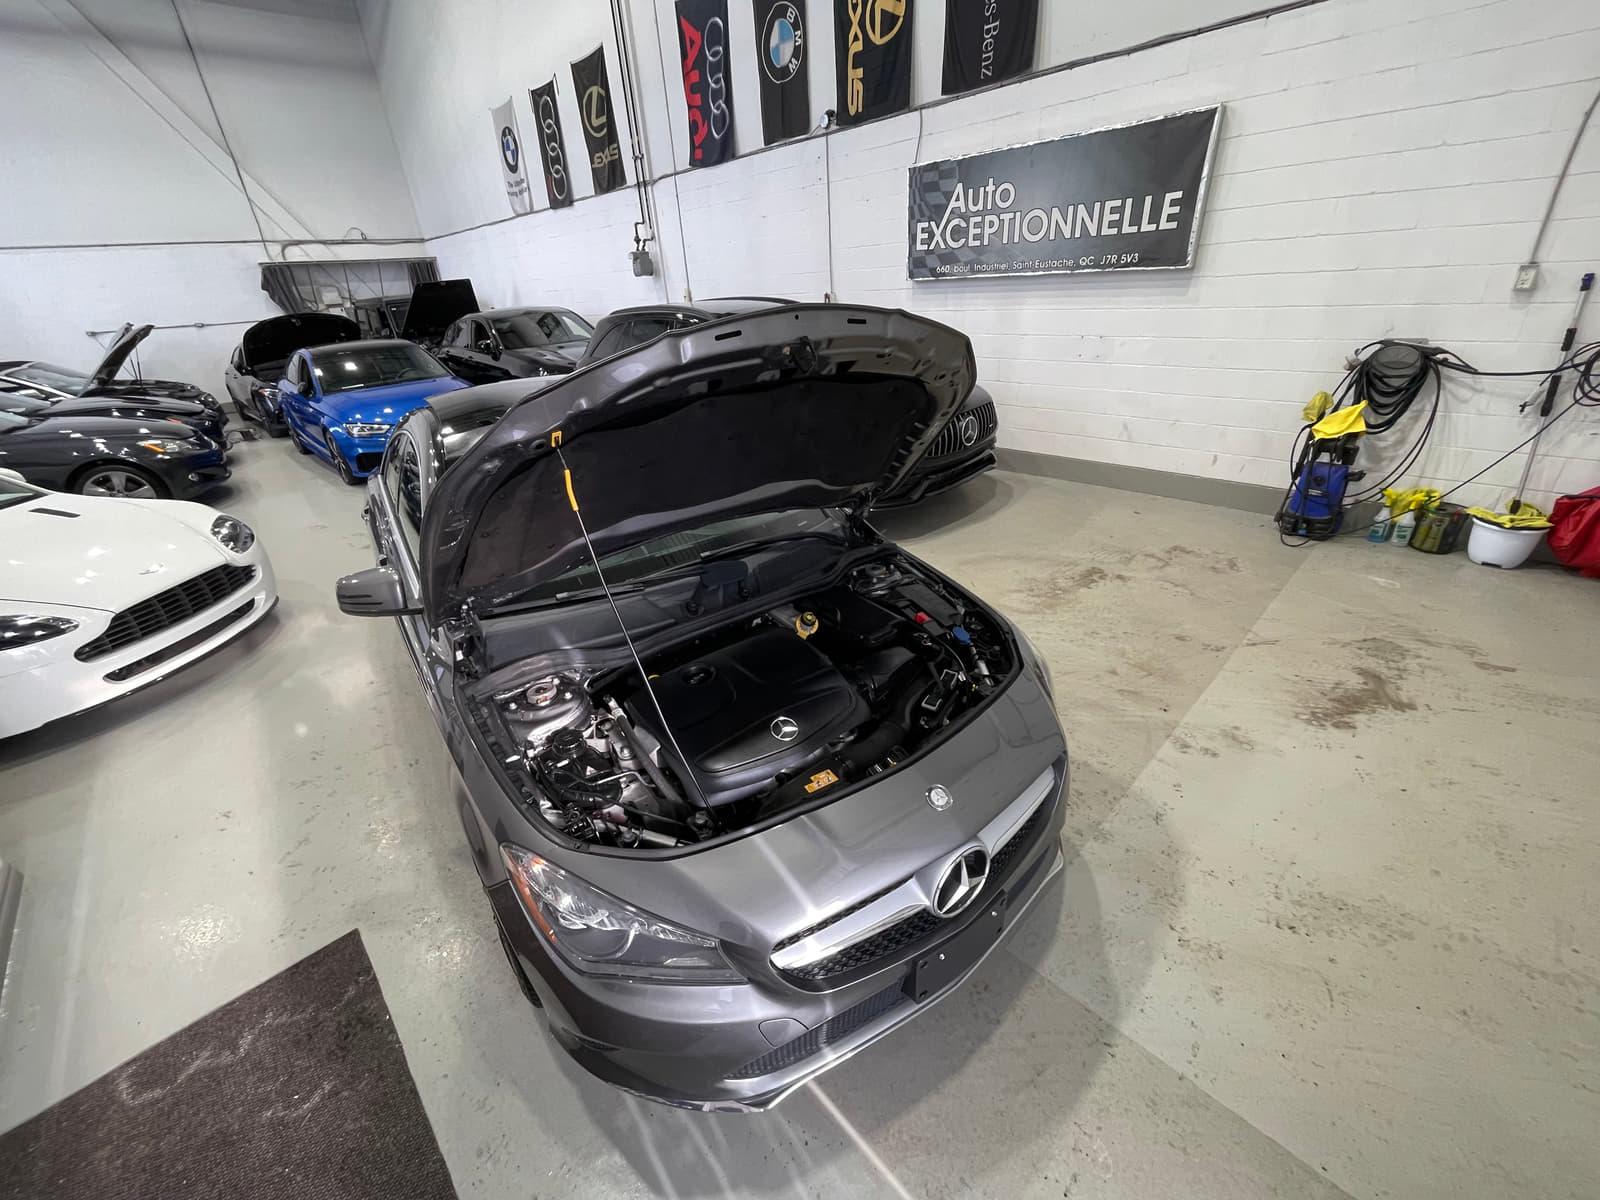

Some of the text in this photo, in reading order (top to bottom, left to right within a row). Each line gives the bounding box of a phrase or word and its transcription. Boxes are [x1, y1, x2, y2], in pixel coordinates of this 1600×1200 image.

[948, 177, 1017, 215] Auto
[915, 190, 1184, 252] EXCEPTIONNELLE
[1079, 256, 1095, 266] QC
[1100, 255, 1118, 265] J7R
[1120, 253, 1139, 264] 5V3
